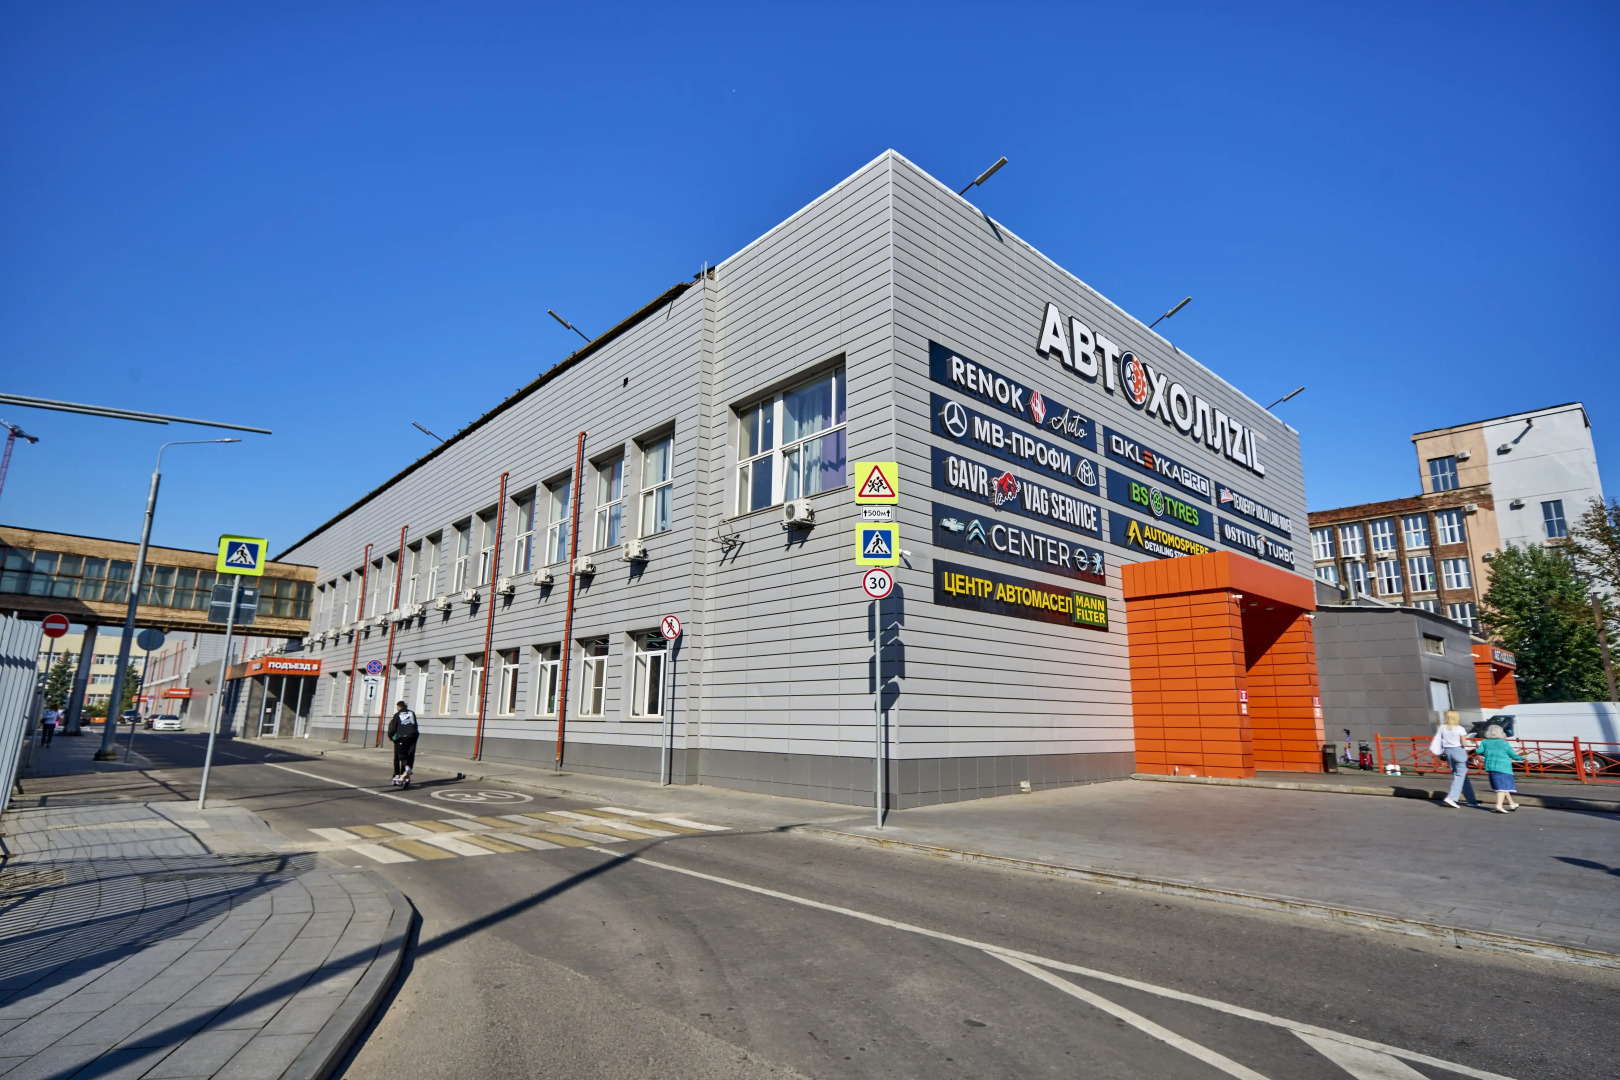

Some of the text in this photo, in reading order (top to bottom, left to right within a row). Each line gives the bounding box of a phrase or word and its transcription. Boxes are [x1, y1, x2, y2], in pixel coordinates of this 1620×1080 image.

[952, 356, 1087, 438] RENOK Auto
[974, 416, 1071, 475] МВ-ПРОФИ
[949, 456, 1098, 531] GAVR VAG SERVICE
[1131, 482, 1199, 526] BS TYRES
[991, 525, 1070, 568] CENTER
[1145, 540, 1174, 557] DETAILING
[1225, 524, 1295, 564] OSTVIN TURBO
[869, 577, 886, 589] 30
[944, 571, 1073, 614] ЦЕНТР АВТОМАСЕЛ
[1076, 594, 1105, 610] MANN
[1076, 608, 1106, 624] FILTER
[268, 661, 311, 671] ПОДЪЕЗД
